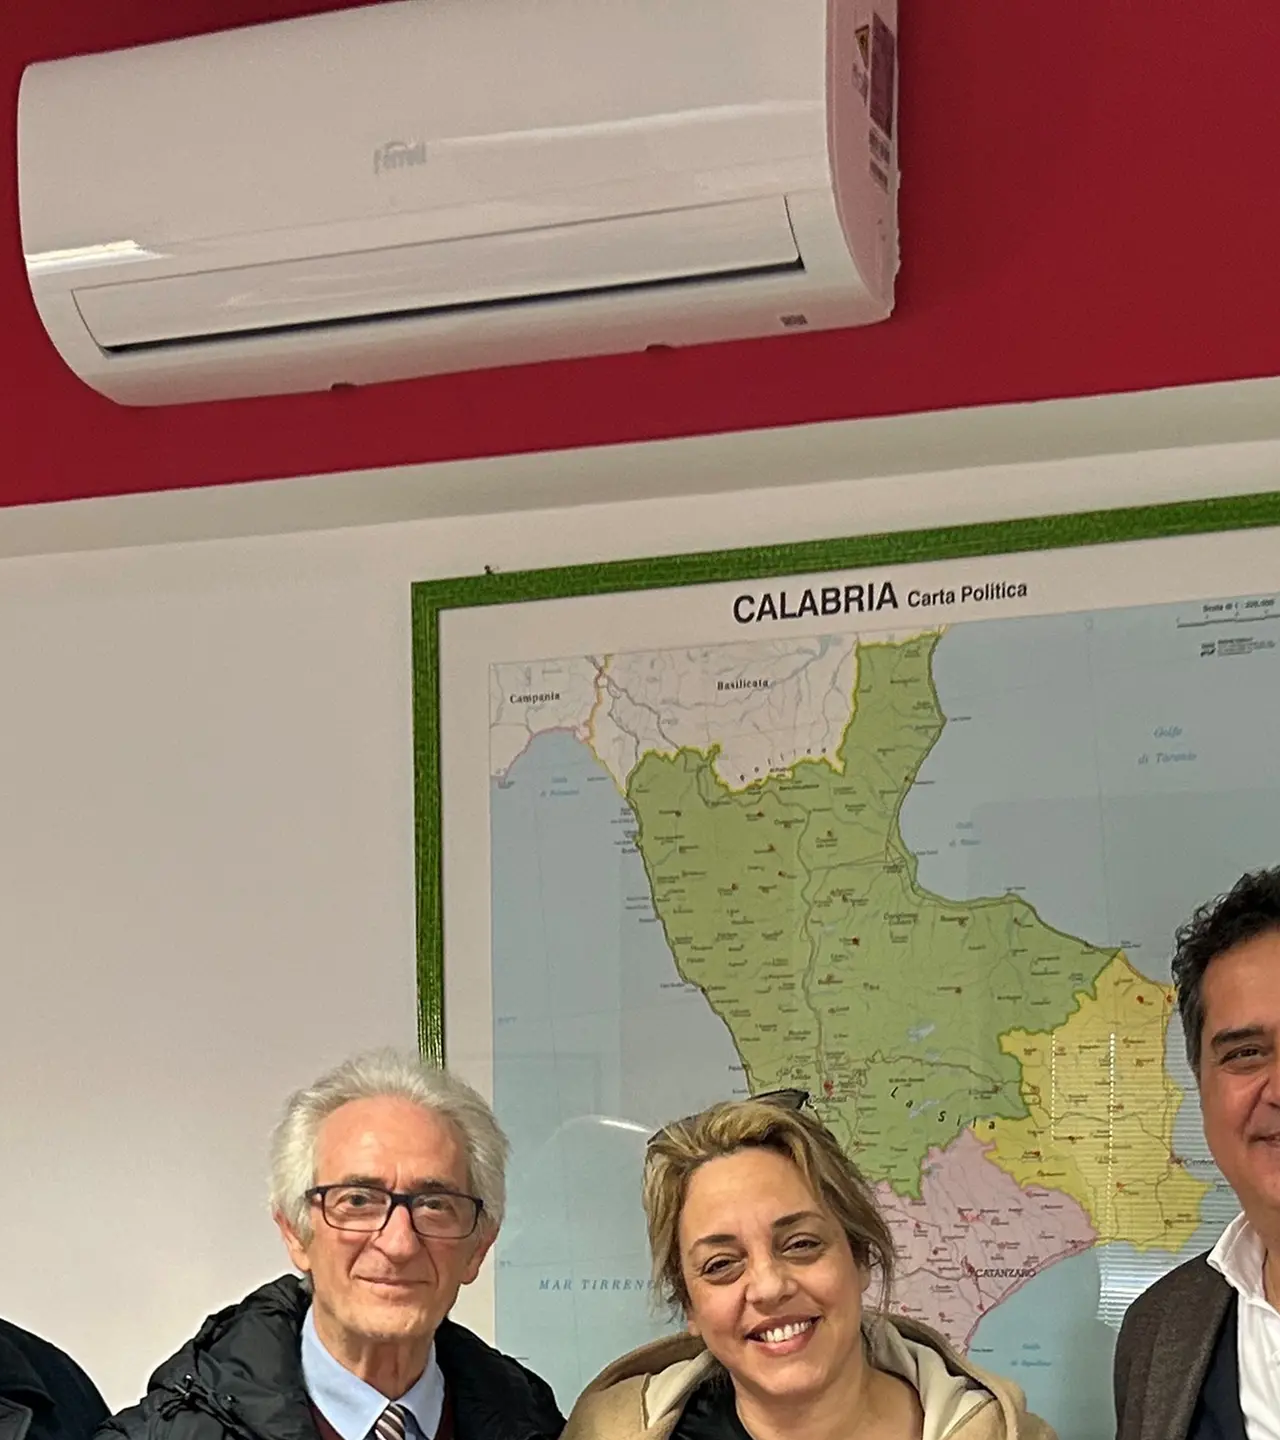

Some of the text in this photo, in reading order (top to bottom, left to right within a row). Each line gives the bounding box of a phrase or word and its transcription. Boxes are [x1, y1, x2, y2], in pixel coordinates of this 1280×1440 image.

[733, 582, 1028, 623] CALABRIA Carta Politica
[717, 678, 770, 691] Basilicata
[510, 691, 561, 704] Campania
[975, 1268, 1037, 1278] CATANZARO
[539, 1279, 572, 1291] MAR
